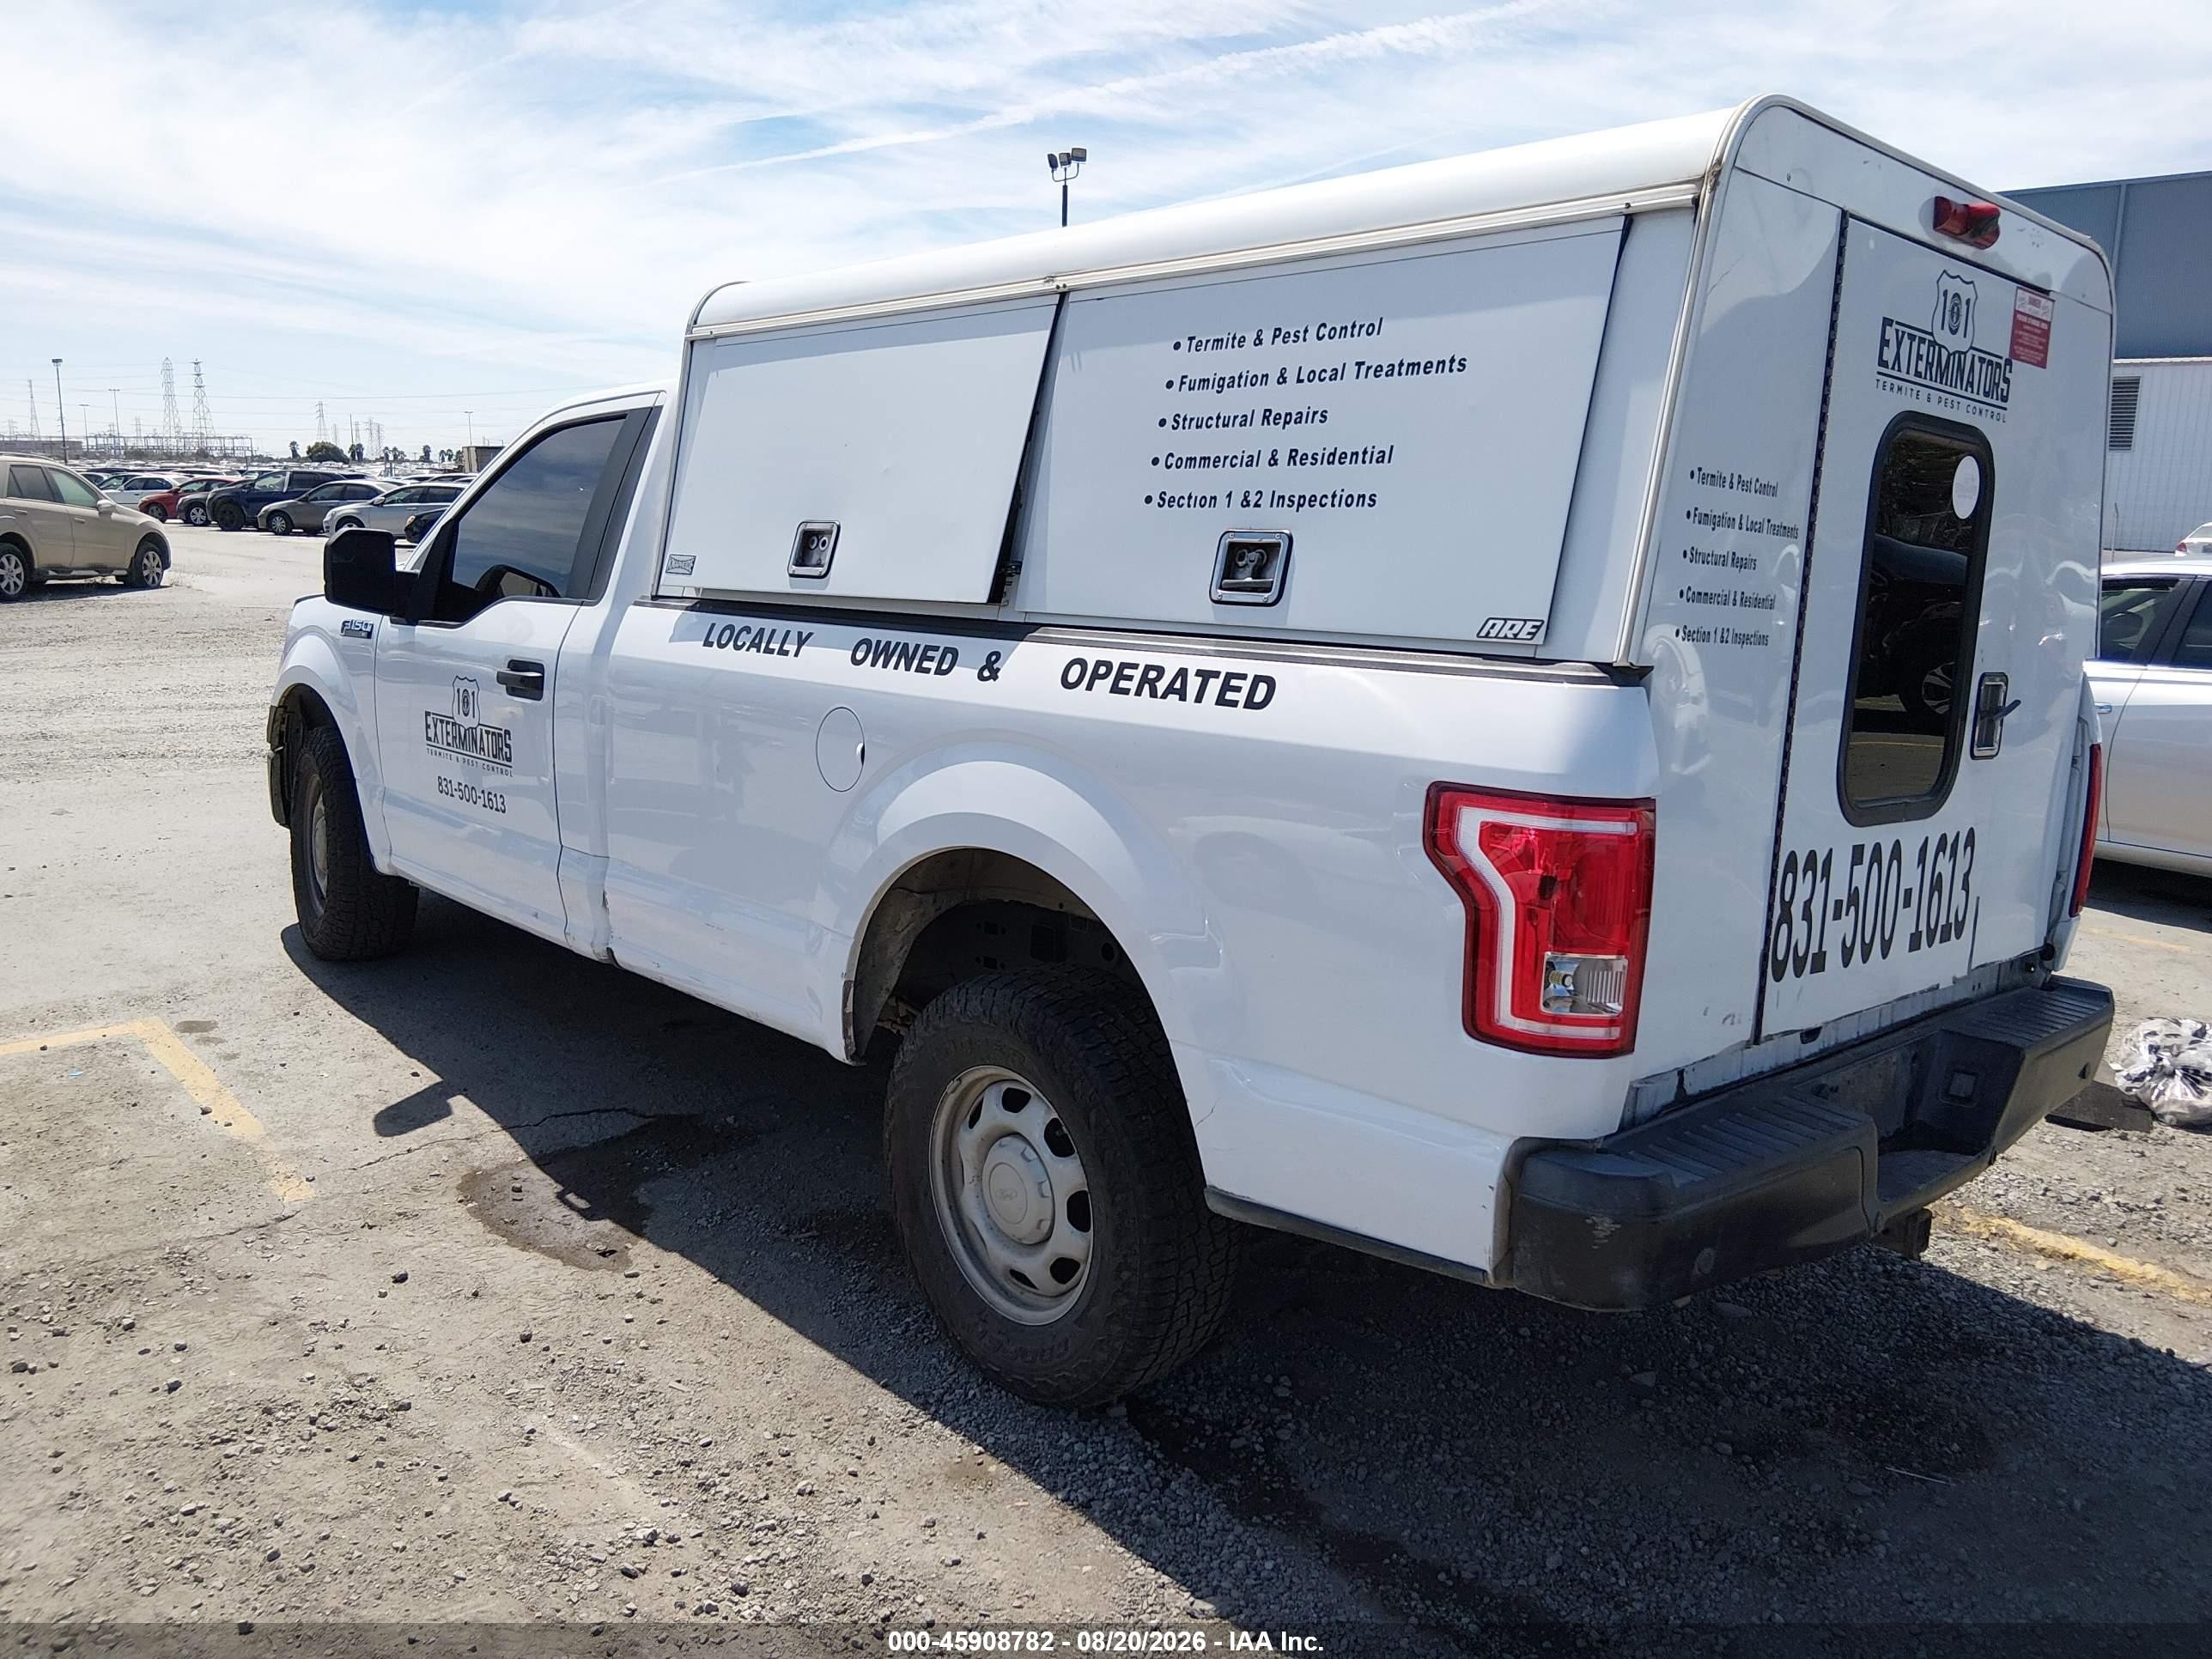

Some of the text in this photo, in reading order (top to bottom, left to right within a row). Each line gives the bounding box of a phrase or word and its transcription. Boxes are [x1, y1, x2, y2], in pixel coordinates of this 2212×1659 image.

[1941, 289, 1971, 338] 101
[1188, 318, 1383, 353] Termite & Pest Control
[1179, 355, 1467, 394] Fumigation & Local Treatments
[1878, 317, 2013, 403] EXTERMINATORS
[1876, 379, 1920, 399] TERMITE
[1938, 397, 1960, 410] PEST
[1966, 404, 2006, 422] CONTROL
[1171, 407, 1328, 431] Structural Repairs
[1164, 445, 1394, 471] Commercial & Residential
[1698, 467, 1778, 497] Termite & Pest Control
[1158, 491, 1217, 509] Section
[1225, 492, 1234, 508] 1
[1270, 489, 1377, 512] Inspections
[1693, 507, 1798, 539] Fumigation & Local Treatments
[1690, 547, 1756, 573] Structural Repairs
[1686, 586, 1776, 610] Commercial & Residential
[1477, 617, 1544, 641] ARE
[1681, 625, 1711, 642] Section
[1713, 628, 1717, 642] 1
[1732, 629, 1769, 649] Inspections
[702, 623, 1276, 711] LOCALLY OWNED & OPERATED
[457, 688, 475, 718] 101
[425, 711, 512, 763] EXTERMINATORS
[428, 749, 453, 761] TERMITE
[463, 758, 478, 767] PEST
[483, 763, 514, 777] CONTROL
[438, 776, 506, 813] 831-500-1613
[1771, 827, 1975, 982] 831-500-1613
